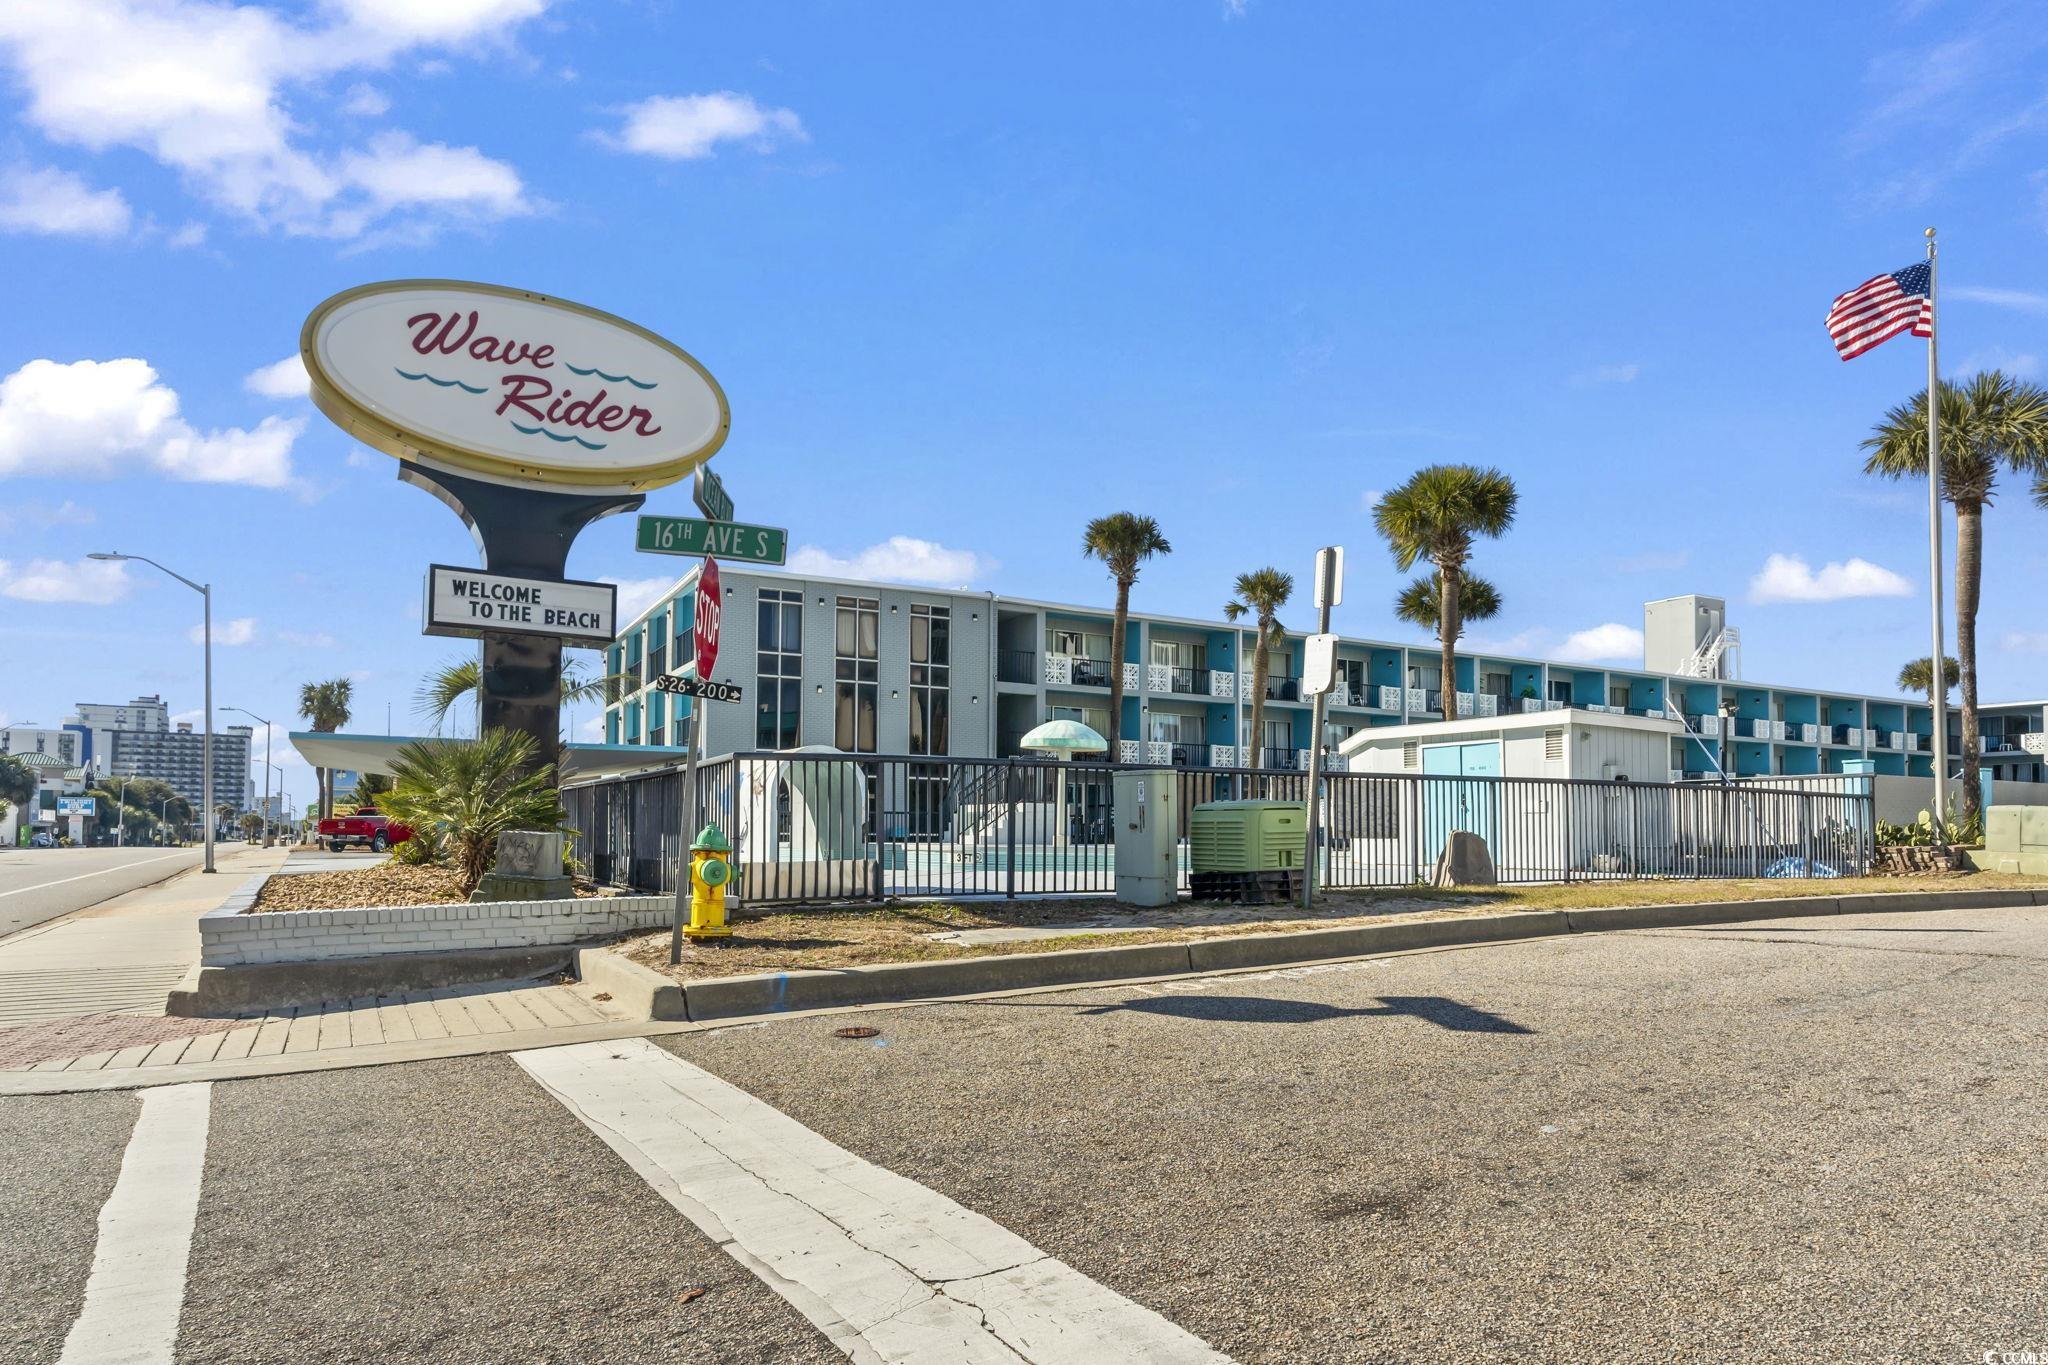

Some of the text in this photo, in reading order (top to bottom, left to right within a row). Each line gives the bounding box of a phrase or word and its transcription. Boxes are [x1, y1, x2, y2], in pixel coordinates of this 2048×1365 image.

[407, 311, 554, 369] Wave
[495, 375, 661, 437] Rider
[655, 521, 768, 557] 16TH AVE S
[452, 579, 541, 604] WELCOME
[469, 601, 600, 629] TO THE BEACH
[696, 589, 720, 647] STOP
[696, 683, 727, 700] 200
[957, 853, 962, 862] 3
